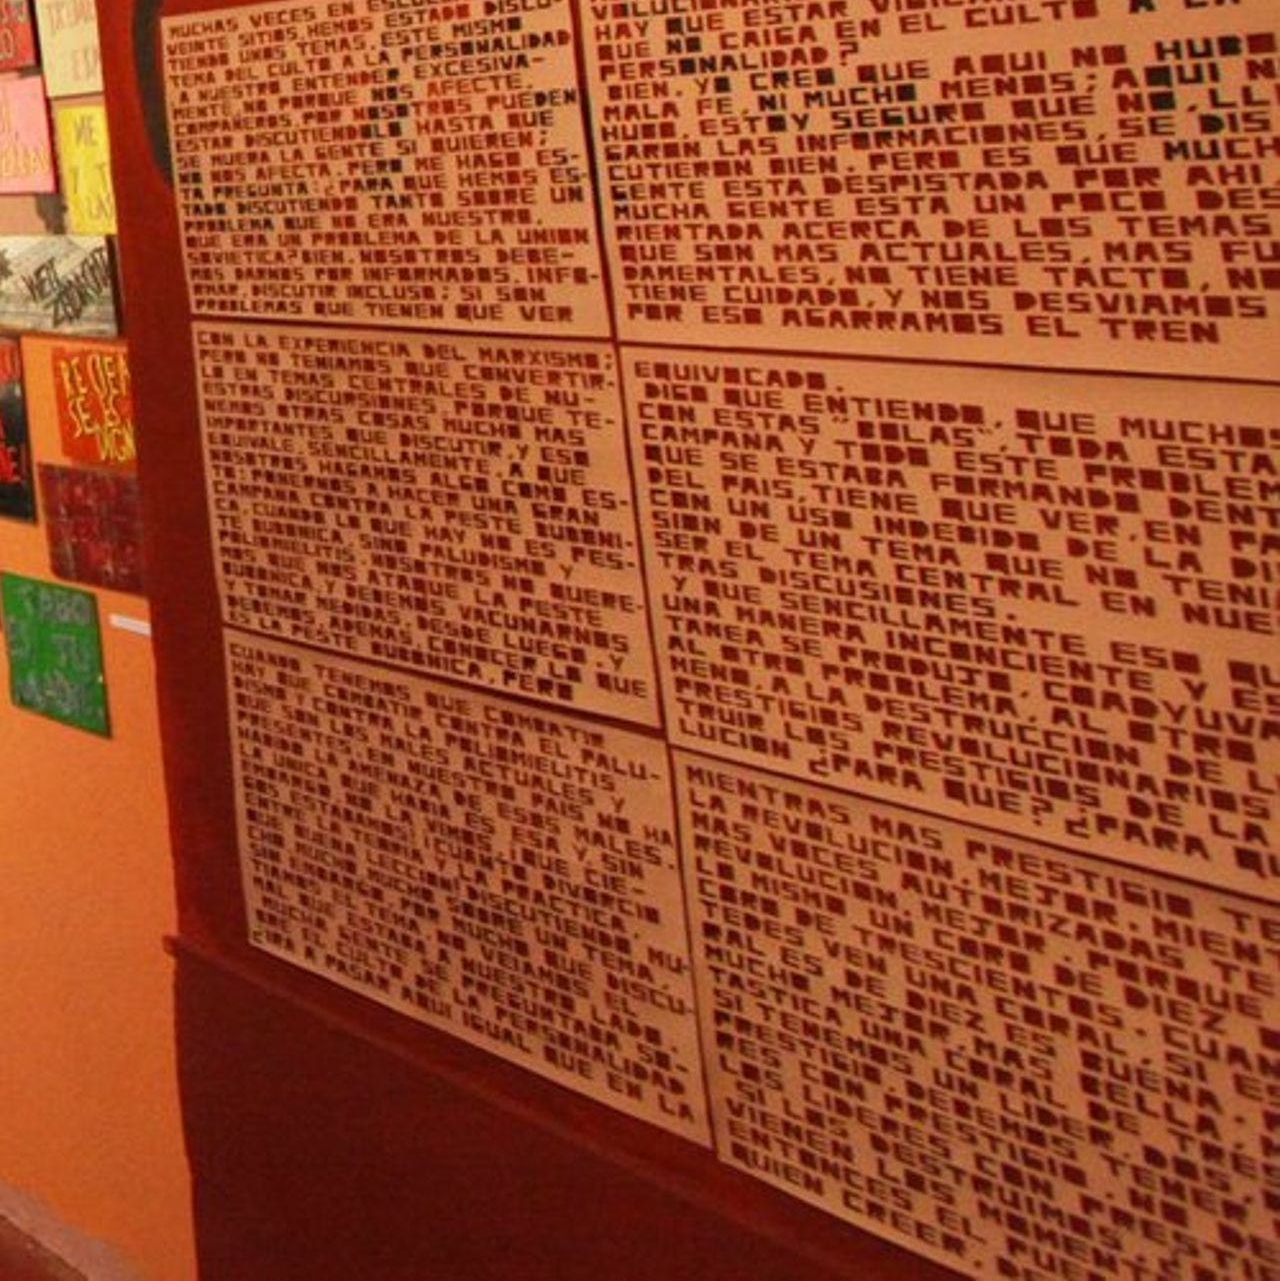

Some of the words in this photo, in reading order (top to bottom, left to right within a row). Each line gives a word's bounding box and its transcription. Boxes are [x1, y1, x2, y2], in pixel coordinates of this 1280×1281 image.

[594, 20, 649, 41] HAY
[664, 12, 723, 36] QUE
[597, 40, 649, 61] QUE
[665, 35, 701, 55] NO
[718, 23, 816, 50] CAIGA
[834, 17, 880, 40] EN
[898, 11, 945, 34] EL
[695, 75, 730, 94] YO
[749, 66, 834, 91] CREO
[856, 59, 928, 84] QUE
[952, 50, 1046, 77] AQUI
[1070, 43, 1126, 68] NO
[1154, 31, 1277, 61] HUBO
[609, 181, 704, 201] GENTE
[722, 178, 805, 197] ESTA
[821, 170, 1048, 194] DESPISTADA
[1073, 166, 1161, 188] POR
[615, 223, 763, 241] RIENTADA
[781, 219, 920, 240] ACERCA
[942, 218, 988, 238] DE
[1013, 217, 1092, 237] LOS
[1124, 214, 1272, 237] TEMAS
[626, 302, 682, 321] POR
[701, 304, 762, 325] ESO
[780, 305, 1003, 336] AGARRAMOS
[1025, 315, 1080, 338] EL
[1099, 317, 1219, 344] TREN
[643, 443, 702, 468] QUE
[718, 450, 758, 473] SE
[775, 456, 906, 489] ESTABA
[929, 471, 1140, 513] FORMANDO
[648, 487, 711, 513] CON
[726, 496, 770, 520] UN
[787, 504, 852, 530] USO
[873, 513, 1040, 554] INDEBIDO
[1066, 536, 1116, 562] DE
[1143, 545, 1202, 573] LA
[653, 529, 709, 554] SER
[724, 539, 763, 562] EL
[783, 547, 875, 578] TEMA
[894, 561, 1078, 608] CENTRAL
[1100, 589, 1156, 618] EN
[656, 549, 738, 579] TRAS
[661, 592, 720, 619] UNA
[735, 603, 865, 644] MANERA
[885, 626, 1152, 696] INCONCIENTE
[1183, 678, 1207, 702] Y
[675, 695, 764, 733] TRUIR
[783, 719, 849, 753] LOS
[872, 736, 1100, 810] PRESTIGIOS
[1126, 794, 1182, 827] DE
[1208, 812, 1268, 847] LA
[685, 764, 850, 826] MIENTRAS
[869, 812, 943, 851] MAS
[965, 837, 1192, 920] PRESTIGIO
[690, 809, 751, 844] MAS
[768, 831, 879, 882] VOCES
[899, 869, 1184, 972] AUTORIZADAS
